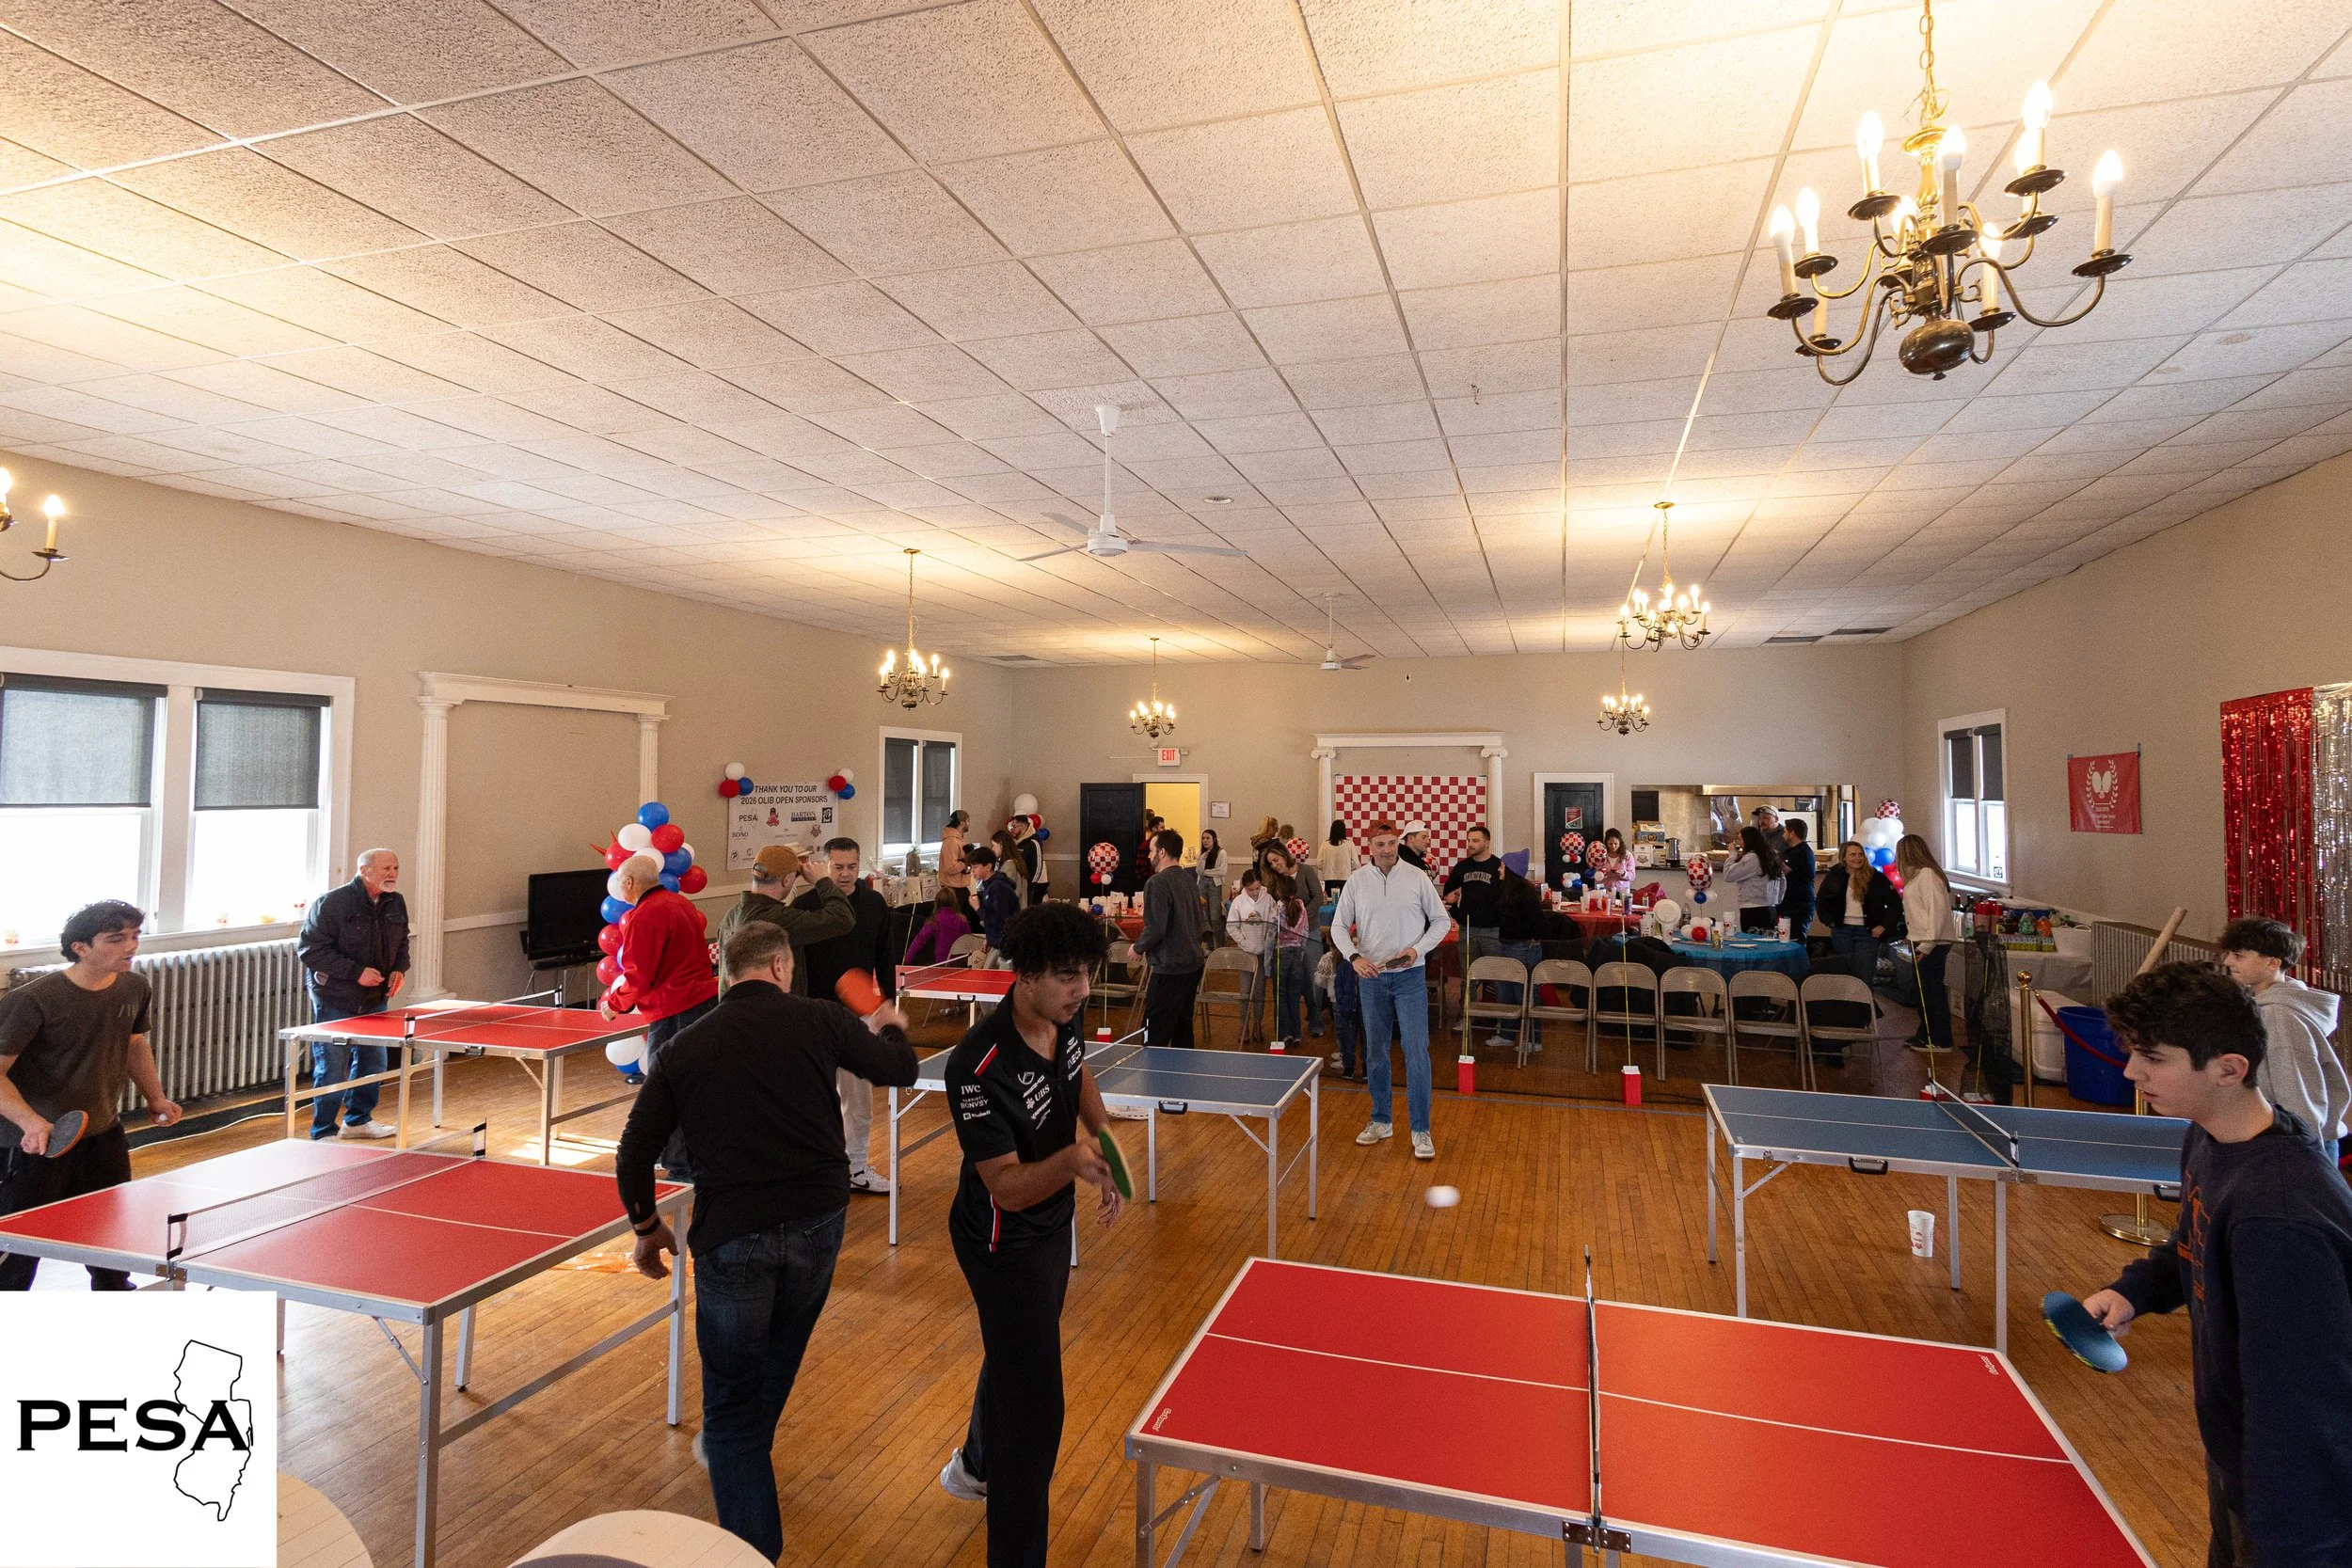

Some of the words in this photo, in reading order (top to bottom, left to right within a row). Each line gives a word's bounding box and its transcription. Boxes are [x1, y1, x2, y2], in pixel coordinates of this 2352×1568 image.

[1162, 749, 1175, 761] EXIT
[755, 785, 778, 794] THANK
[803, 784, 817, 793] OUR
[740, 797, 757, 805] 2026
[775, 796, 794, 804] OPEN
[795, 795, 828, 804] SPONSORS
[739, 814, 757, 822] PESA
[961, 1085, 981, 1095] IWC
[1034, 1084, 1051, 1101] UBS
[960, 1099, 989, 1109] BONVOY
